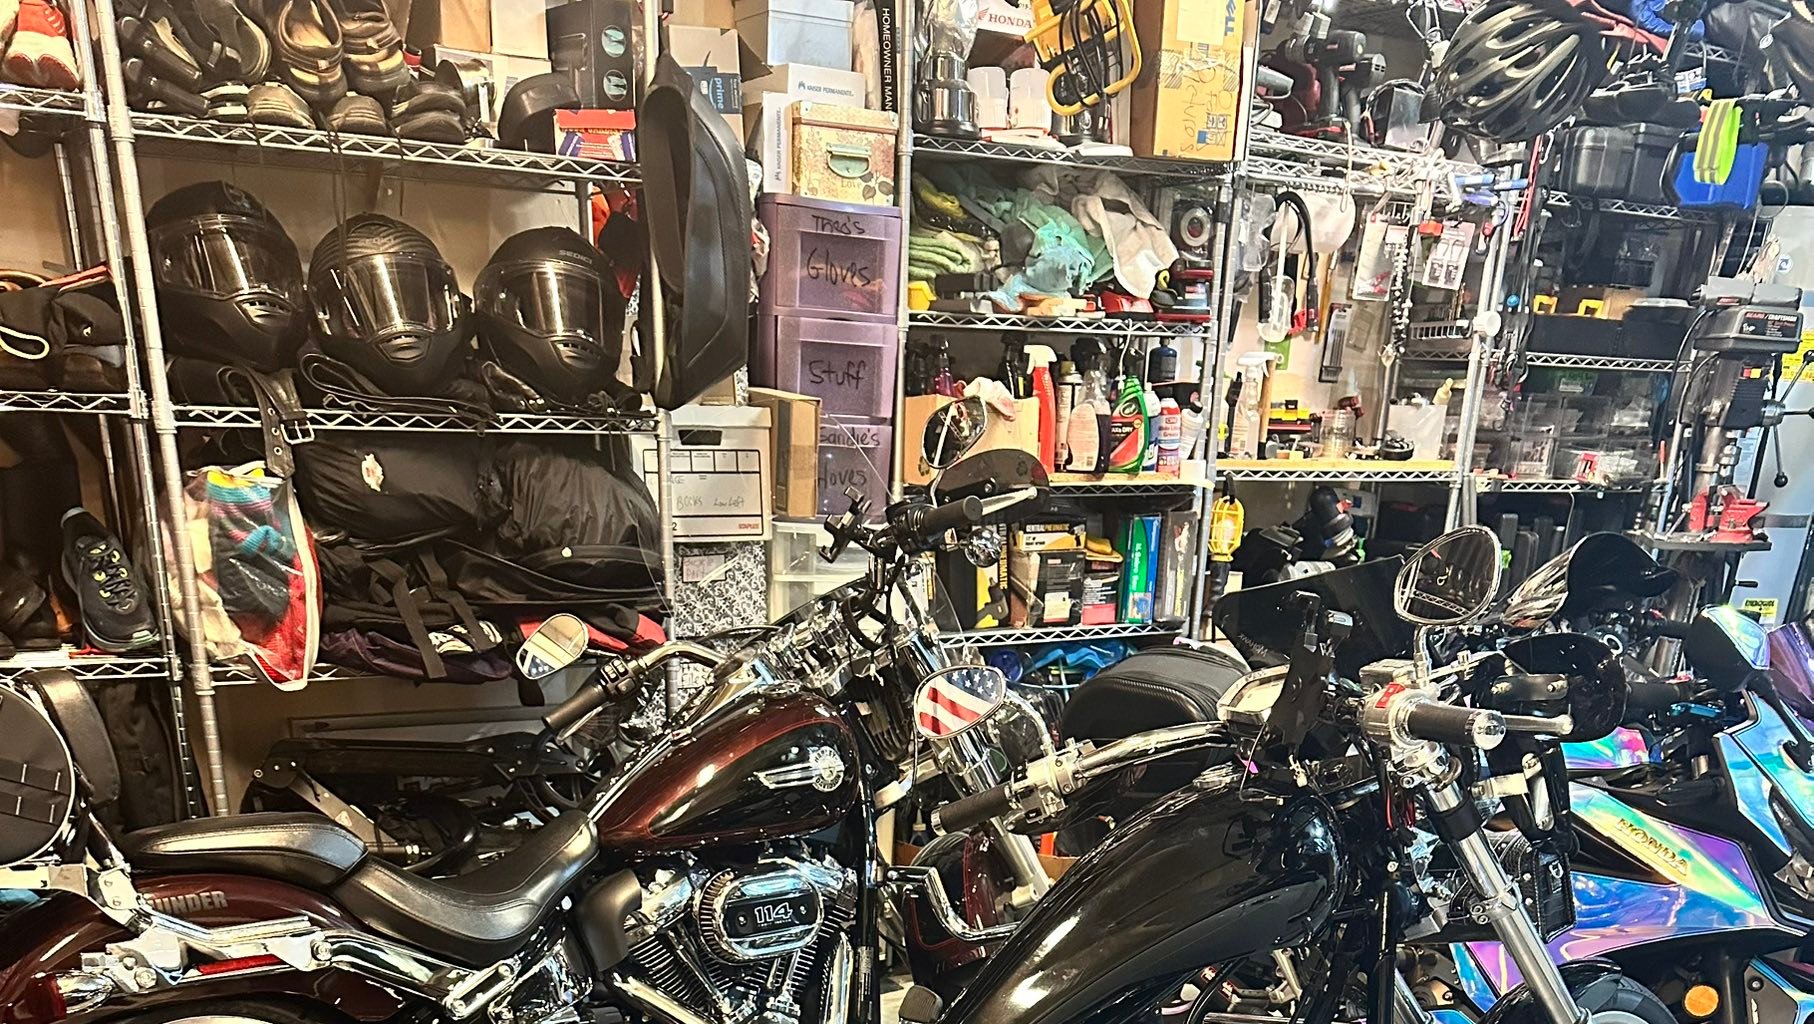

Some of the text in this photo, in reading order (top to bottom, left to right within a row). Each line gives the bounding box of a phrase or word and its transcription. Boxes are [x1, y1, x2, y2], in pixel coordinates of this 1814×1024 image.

[989, 13, 1032, 29] HONDA
[882, 8, 892, 83] HOMEOWNER
[713, 77, 725, 110] prime
[559, 249, 593, 265] SEDICI
[806, 247, 871, 287] Gloves
[809, 359, 866, 390] Stuff
[1616, 817, 1689, 877] HONDA
[754, 902, 794, 924] 114
